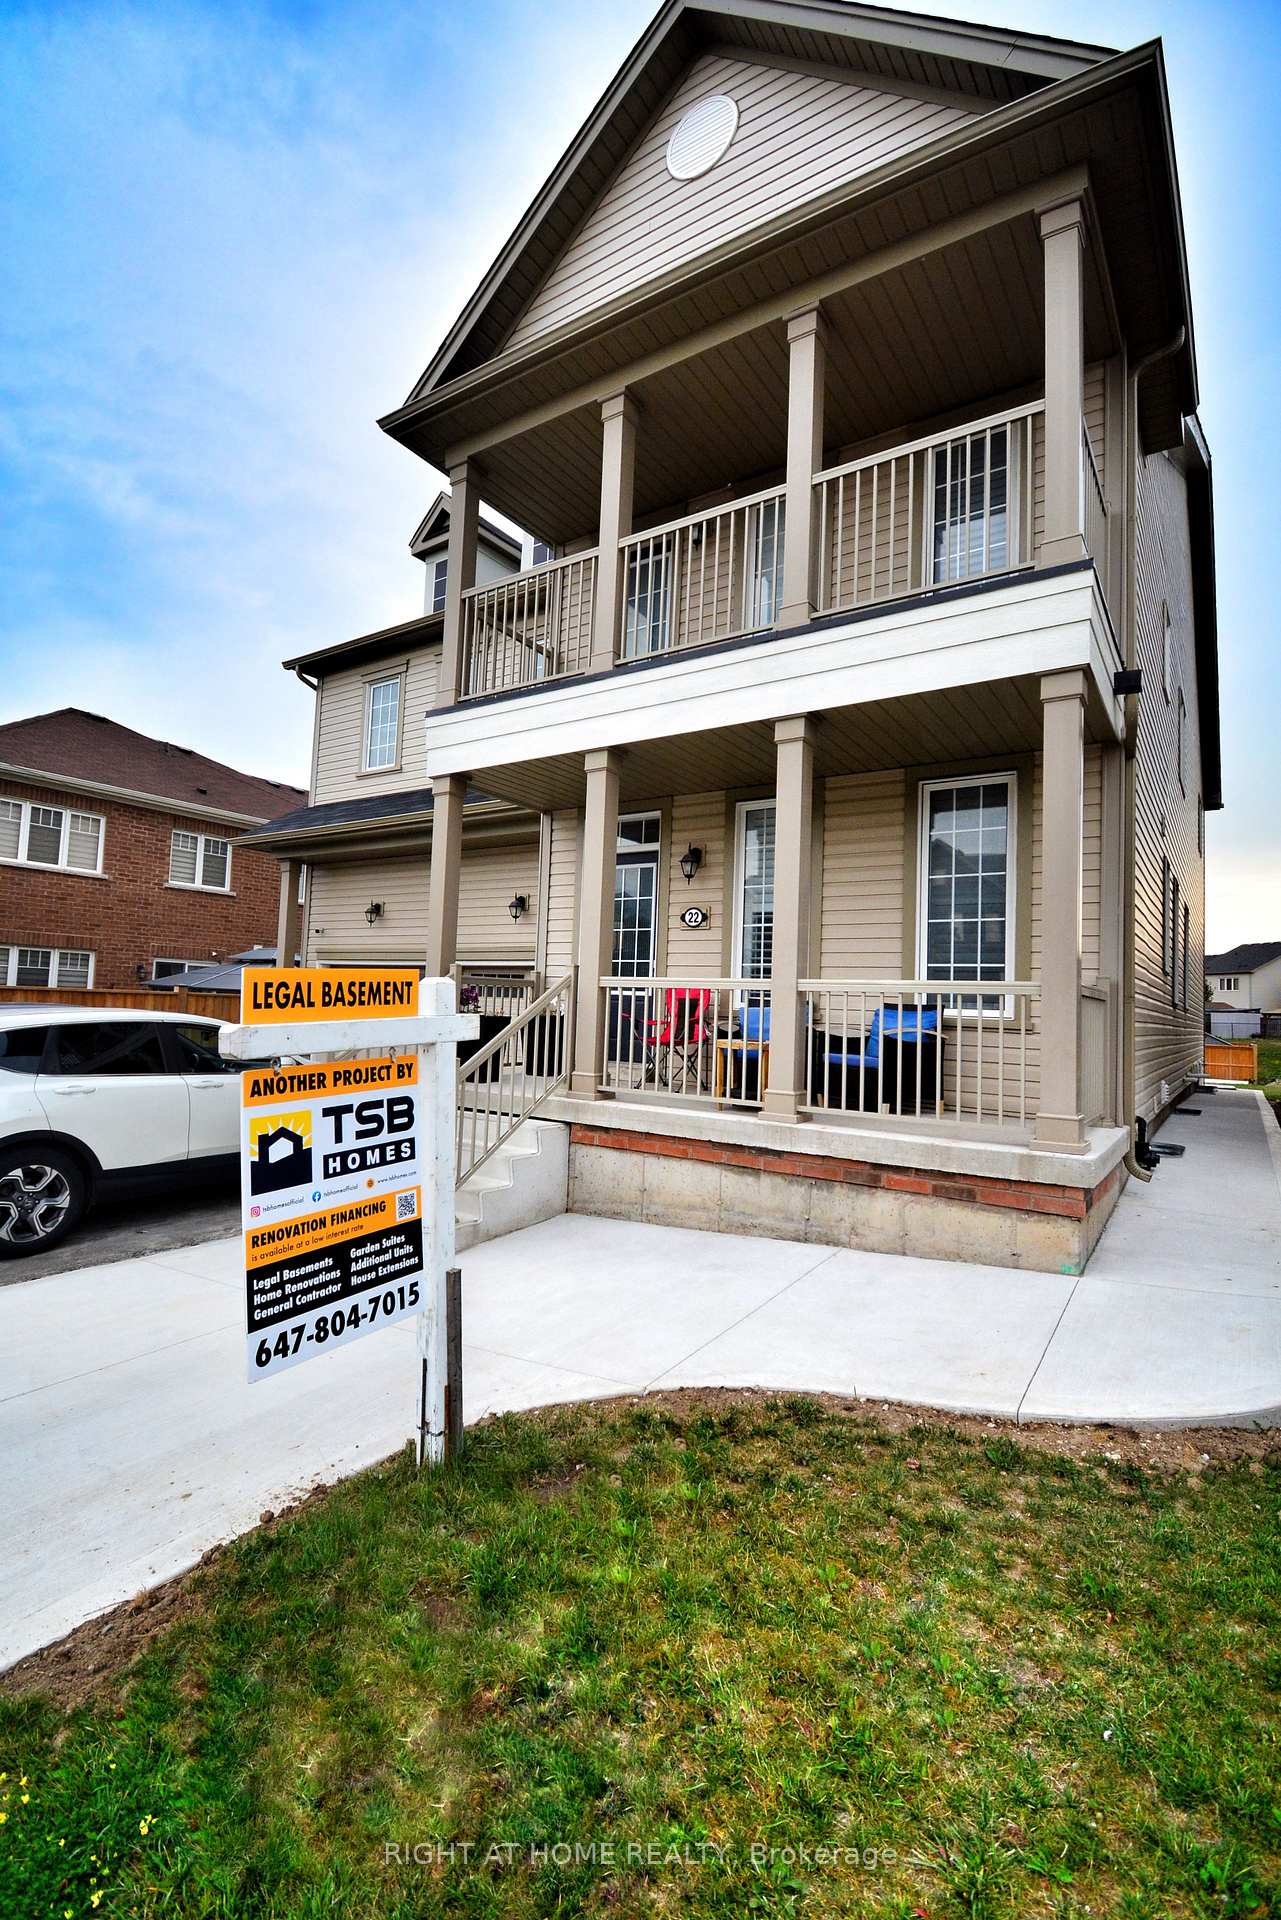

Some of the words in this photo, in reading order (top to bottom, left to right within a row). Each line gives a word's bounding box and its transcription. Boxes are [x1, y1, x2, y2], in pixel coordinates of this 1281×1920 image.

[688, 912, 699, 923] 22
[253, 981, 315, 1009] LEGAL
[322, 981, 413, 1008] BASEMENT
[250, 1073, 327, 1098] ANOTHER
[333, 1065, 392, 1087] PROJECT
[397, 1062, 413, 1079] BY
[322, 1095, 415, 1145] TSB
[328, 1142, 411, 1174] HOMES
[251, 1216, 327, 1249] RENOVATION
[331, 1200, 386, 1226] FINANCING
[251, 1254, 257, 1262] is
[259, 1244, 294, 1260] available
[296, 1241, 303, 1250] at
[312, 1234, 325, 1245] low
[326, 1229, 350, 1240] interest
[351, 1224, 364, 1234] rate
[350, 1242, 380, 1259] Garden
[382, 1234, 406, 1249] Suites
[350, 1252, 392, 1273] Additional
[394, 1244, 414, 1258] Units
[253, 1271, 280, 1291] Legal
[283, 1257, 333, 1281] Basements
[253, 1289, 282, 1306] Home
[285, 1269, 341, 1295] Renovations
[351, 1271, 376, 1287] House
[378, 1256, 419, 1276] Extensions
[253, 1300, 293, 1321] General
[296, 1282, 342, 1306] Contractor
[255, 1281, 420, 1368] 647-804-7015
